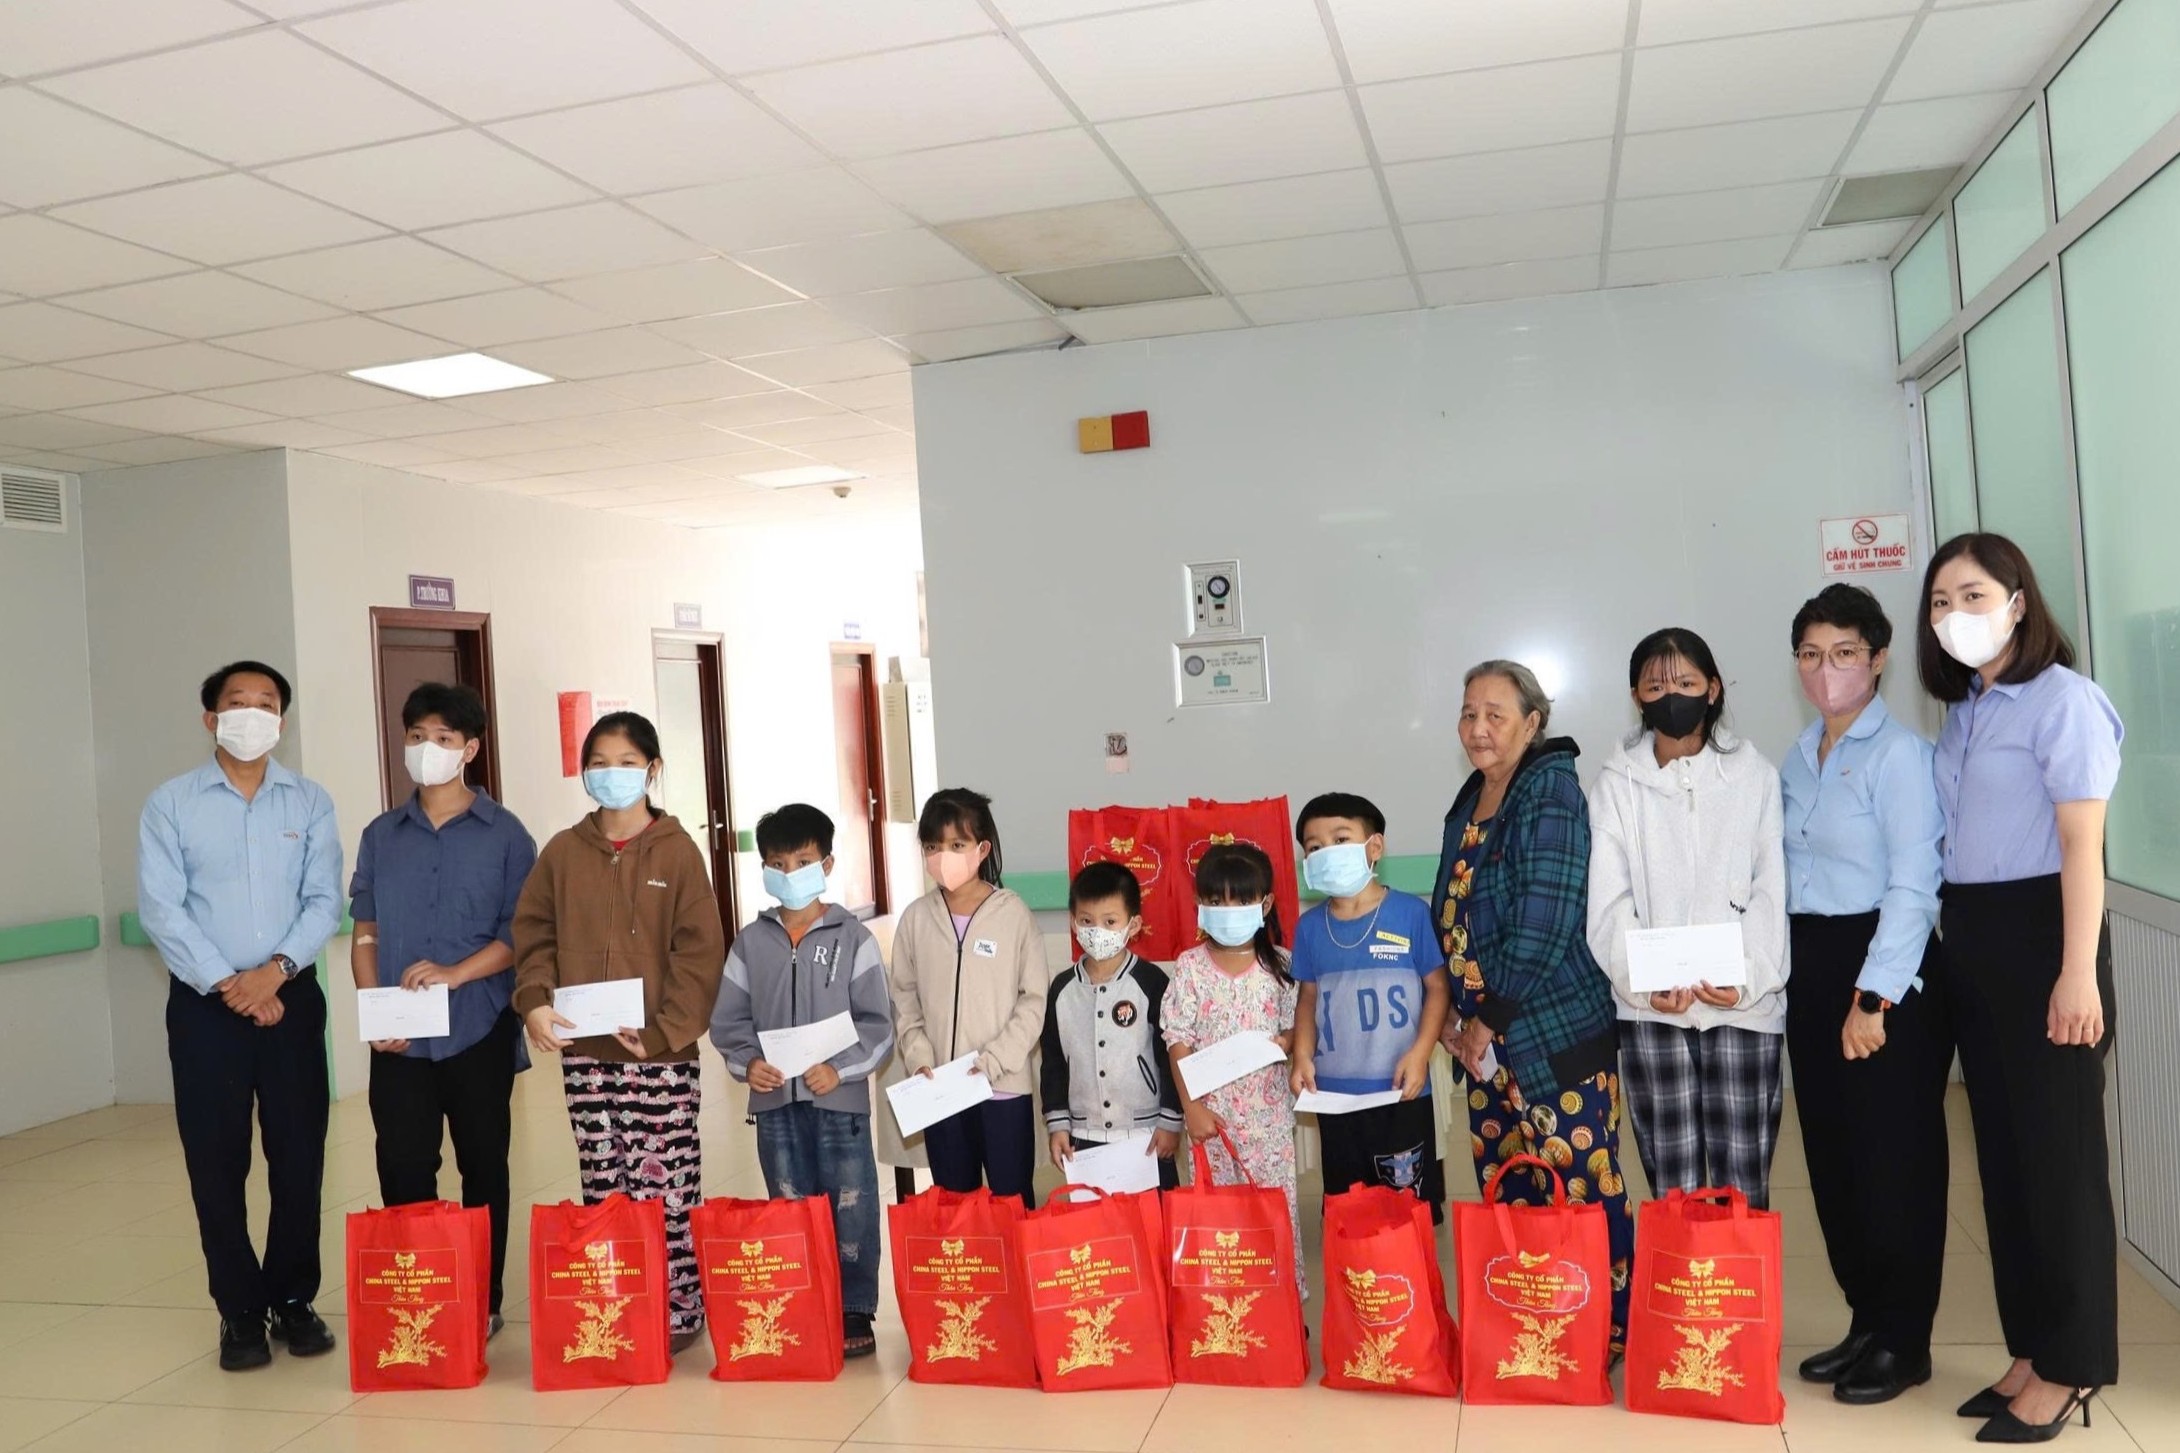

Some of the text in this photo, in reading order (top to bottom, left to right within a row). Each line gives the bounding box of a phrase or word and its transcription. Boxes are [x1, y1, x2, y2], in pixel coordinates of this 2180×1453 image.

[1827, 544, 1906, 561] CẤM HÚT THUỐC
[1860, 560, 1875, 569] SINH
[813, 945, 828, 965] R
[569, 1262, 586, 1270] CÔNG
[1038, 1280, 1057, 1288] CHINA
[1059, 1277, 1078, 1285] STEEL
[1086, 1269, 1109, 1278] NIPPON
[1111, 1266, 1130, 1274] STEEL
[1056, 1269, 1073, 1277] CÔNG
[1086, 1279, 1100, 1287] NAM
[1490, 1277, 1508, 1285] CHINA
[1671, 1278, 1690, 1287] CÔNG
[1655, 1283, 1671, 1293] CHINA
[1390, 1293, 1408, 1303] STEEL
